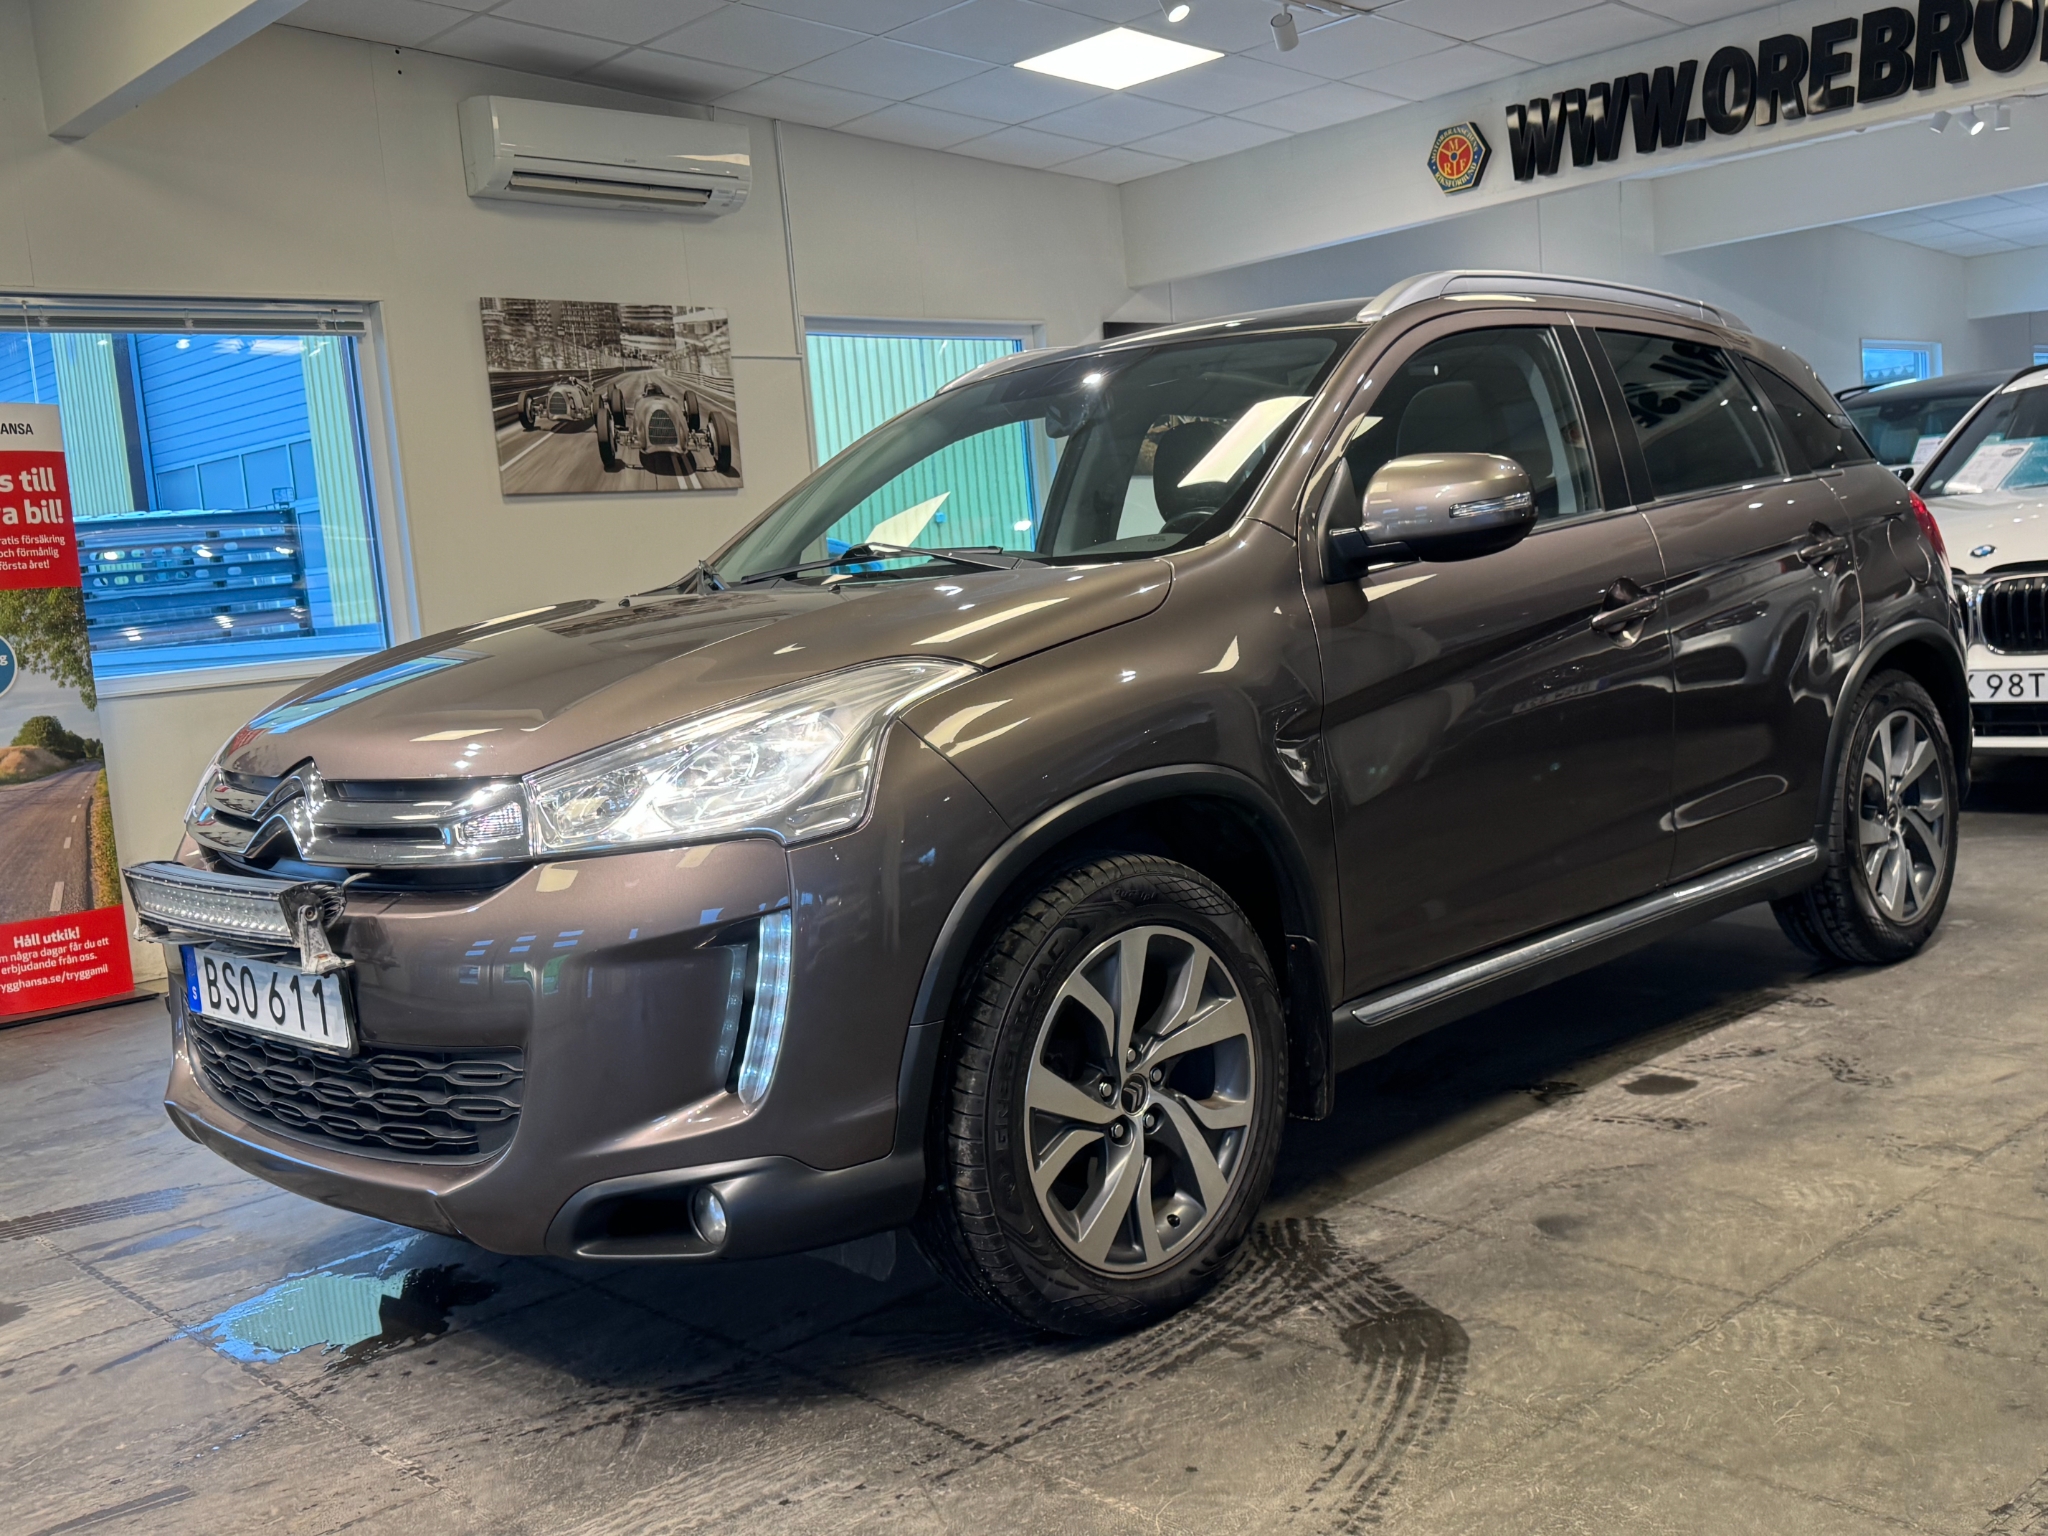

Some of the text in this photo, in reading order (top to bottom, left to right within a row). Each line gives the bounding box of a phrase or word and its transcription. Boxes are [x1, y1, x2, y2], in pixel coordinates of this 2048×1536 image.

[1505, 0, 2048, 182] WWW.OREBRO
[19, 467, 56, 492] till
[0, 506, 19, 525] a
[21, 534, 66, 546] försäkring
[16, 547, 60, 558] förmånlig
[0, 560, 50, 571] första året!
[13, 926, 81, 949] Håll utkik!
[10, 951, 38, 962] några
[40, 946, 67, 958] dagar
[70, 941, 83, 952] får
[84, 939, 96, 949] du
[97, 937, 109, 947] ett
[1, 952, 97, 975] erbjudande från oss.
[0, 964, 108, 993] ygghansa.se/tryggamil
[192, 986, 198, 1000] S
[203, 956, 328, 1037] BSO 611
